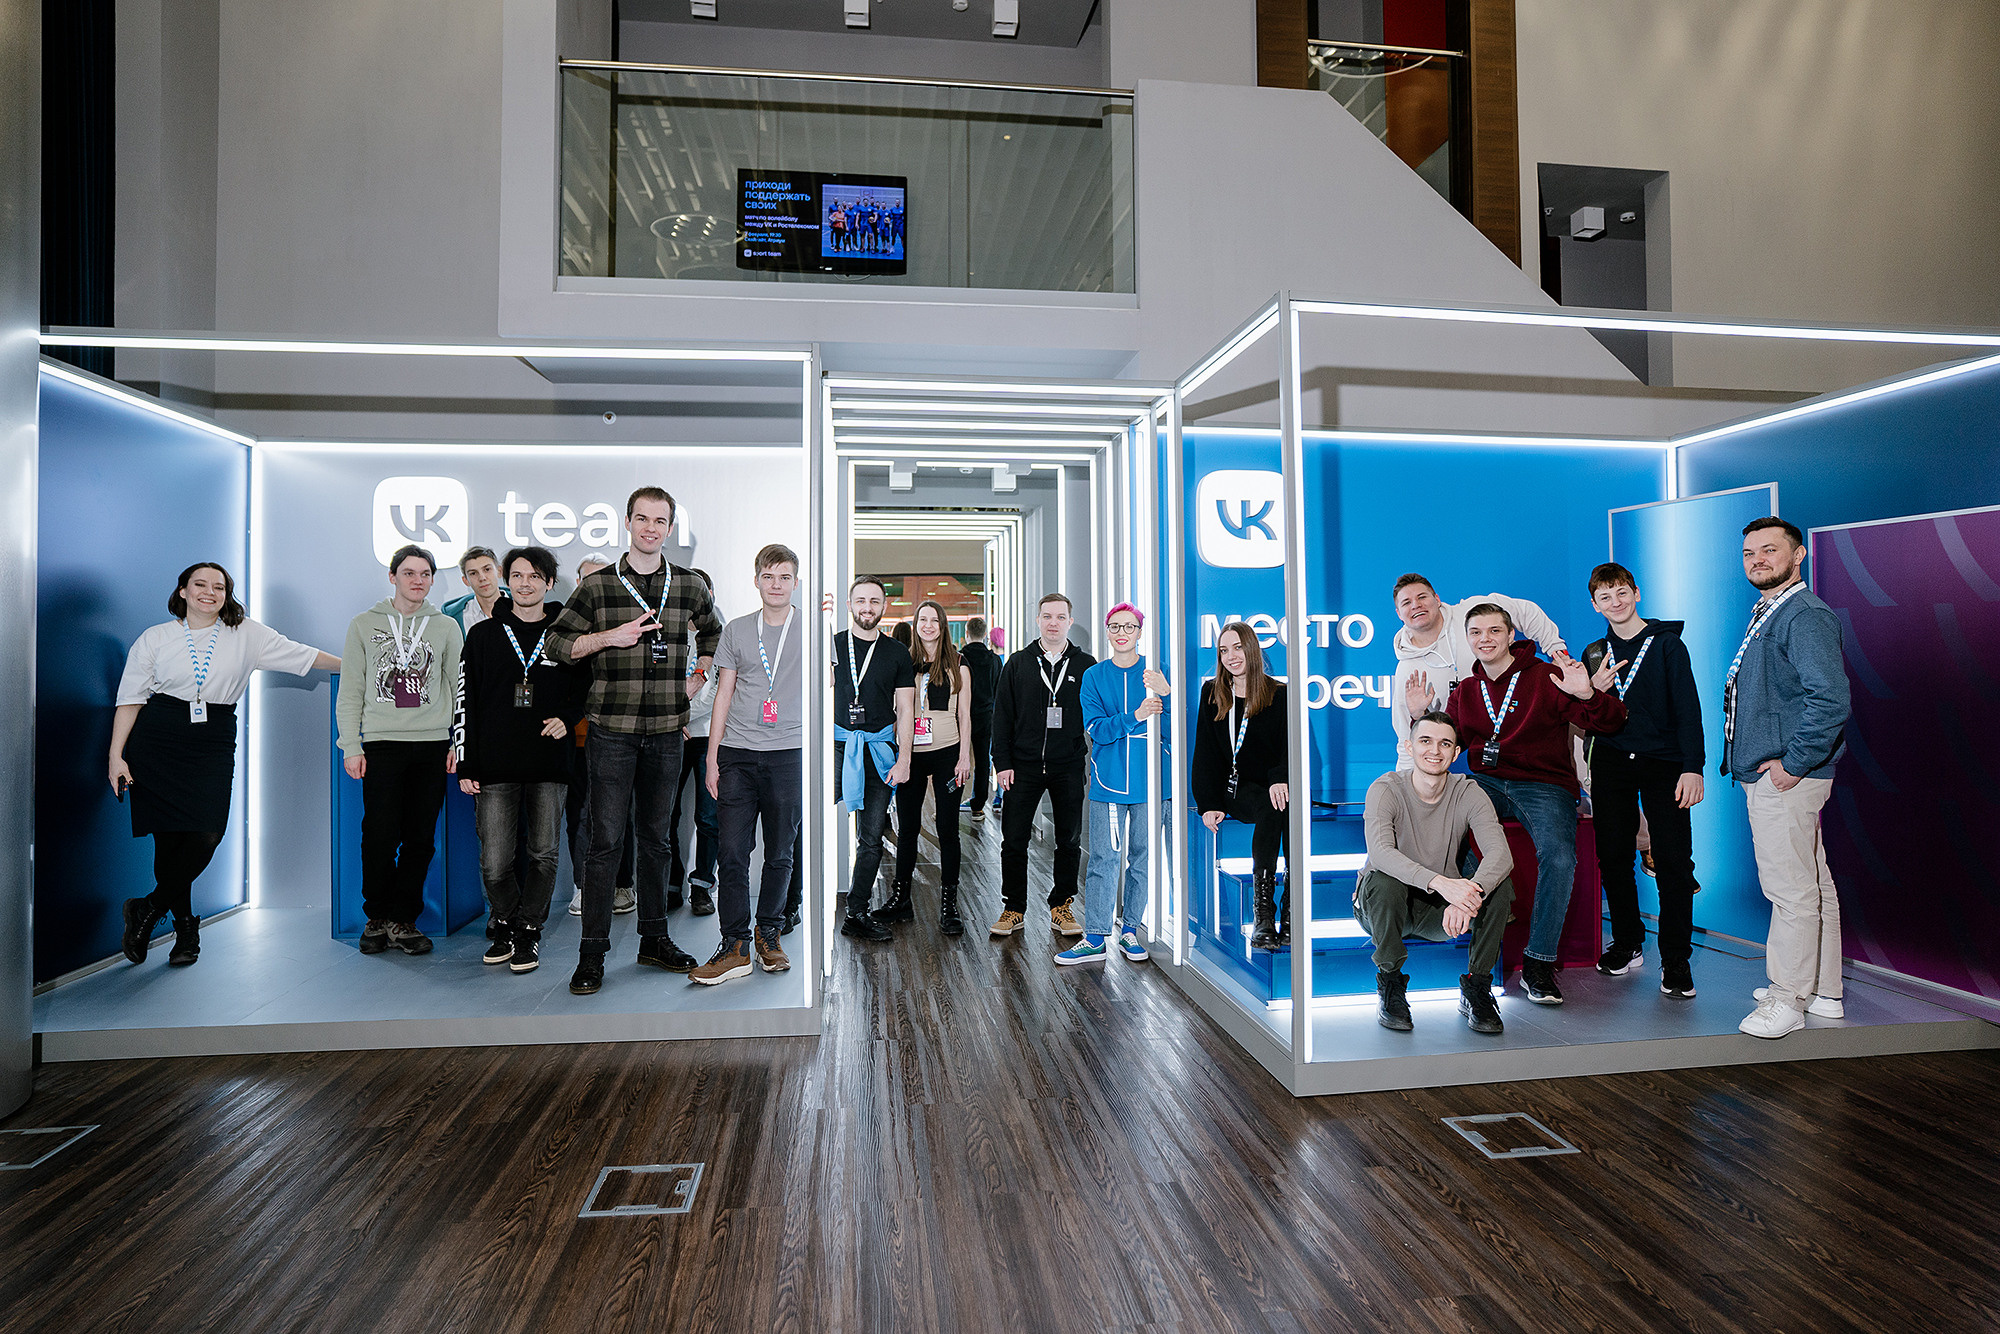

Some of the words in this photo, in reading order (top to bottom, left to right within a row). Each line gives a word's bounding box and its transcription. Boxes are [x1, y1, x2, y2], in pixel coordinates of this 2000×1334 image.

[745, 181, 791, 191] приходи
[745, 191, 811, 202] поддержать
[744, 201, 777, 210] своих
[389, 504, 452, 543] VK
[1215, 499, 1278, 541] VK
[453, 660, 466, 763] SOLANA
